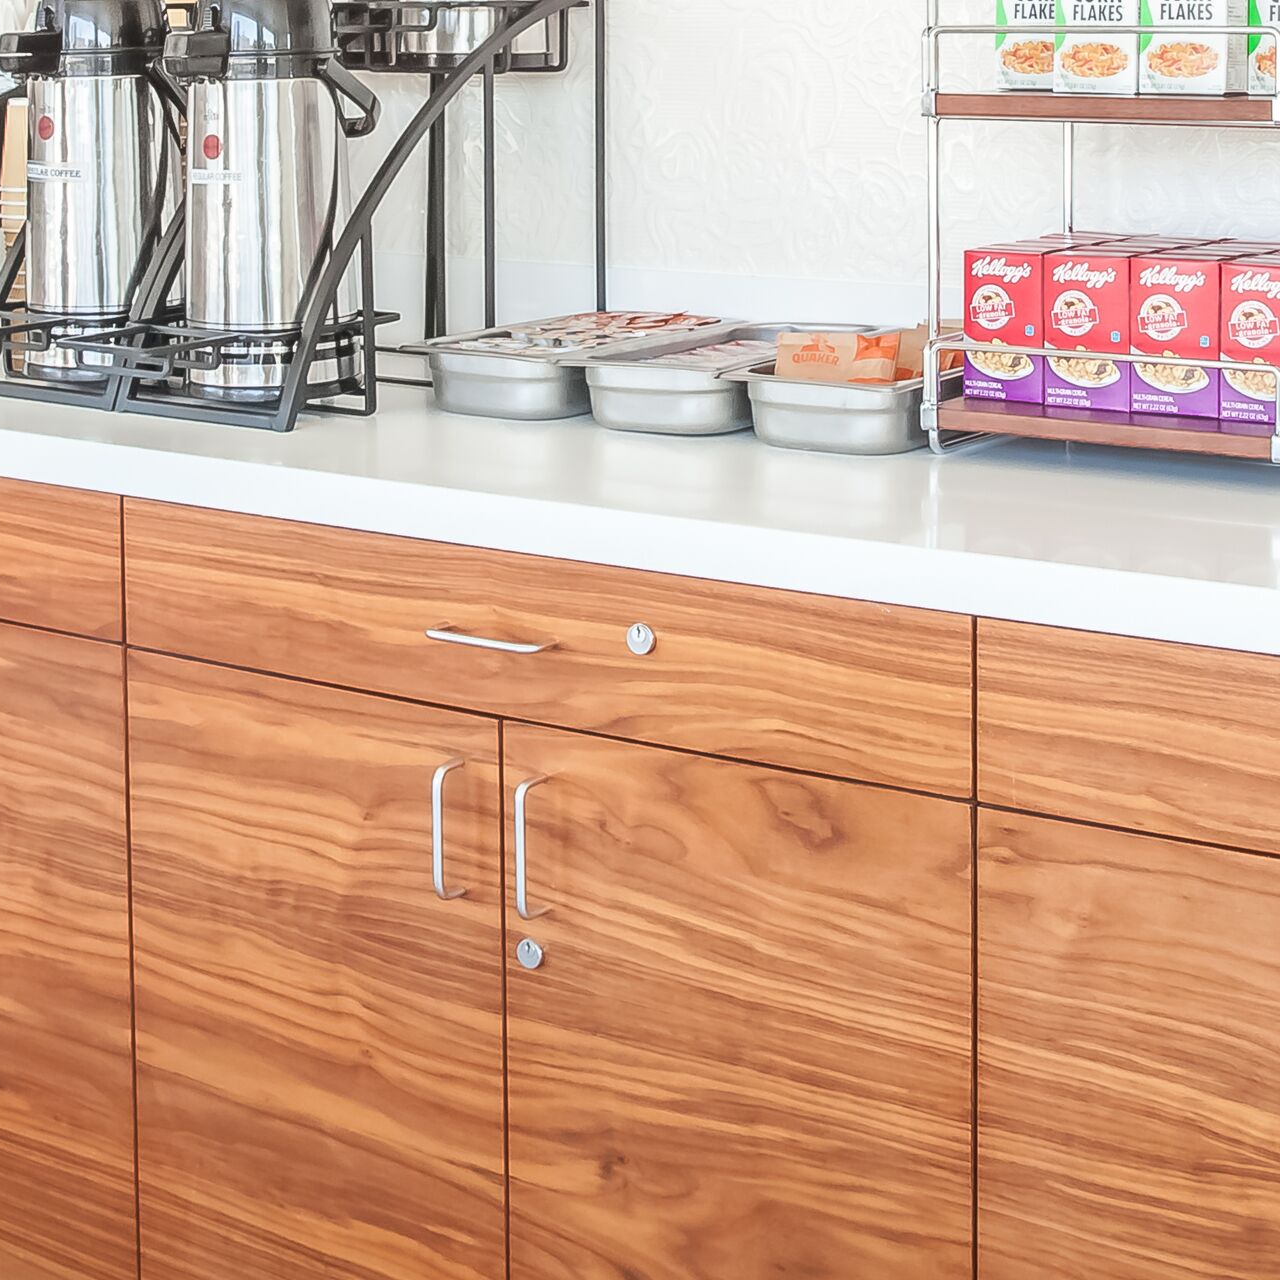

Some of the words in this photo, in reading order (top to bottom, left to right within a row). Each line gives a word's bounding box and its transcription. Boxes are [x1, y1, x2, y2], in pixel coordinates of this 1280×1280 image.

[1014, 3, 1055, 20] FLAKE
[1073, 4, 1123, 22] FLAKES
[1160, 3, 1213, 20] FLAKES
[50, 169, 81, 178] COFFEE
[971, 255, 1032, 283] Kellogg's
[1052, 261, 1117, 288] Kellogg's
[1139, 264, 1206, 293] Kellogg's
[976, 304, 992, 313] LOW
[1058, 311, 1075, 319] LOW
[1145, 314, 1162, 323] LOW
[1235, 320, 1254, 330] LOW
[792, 352, 840, 366] QUAKER
